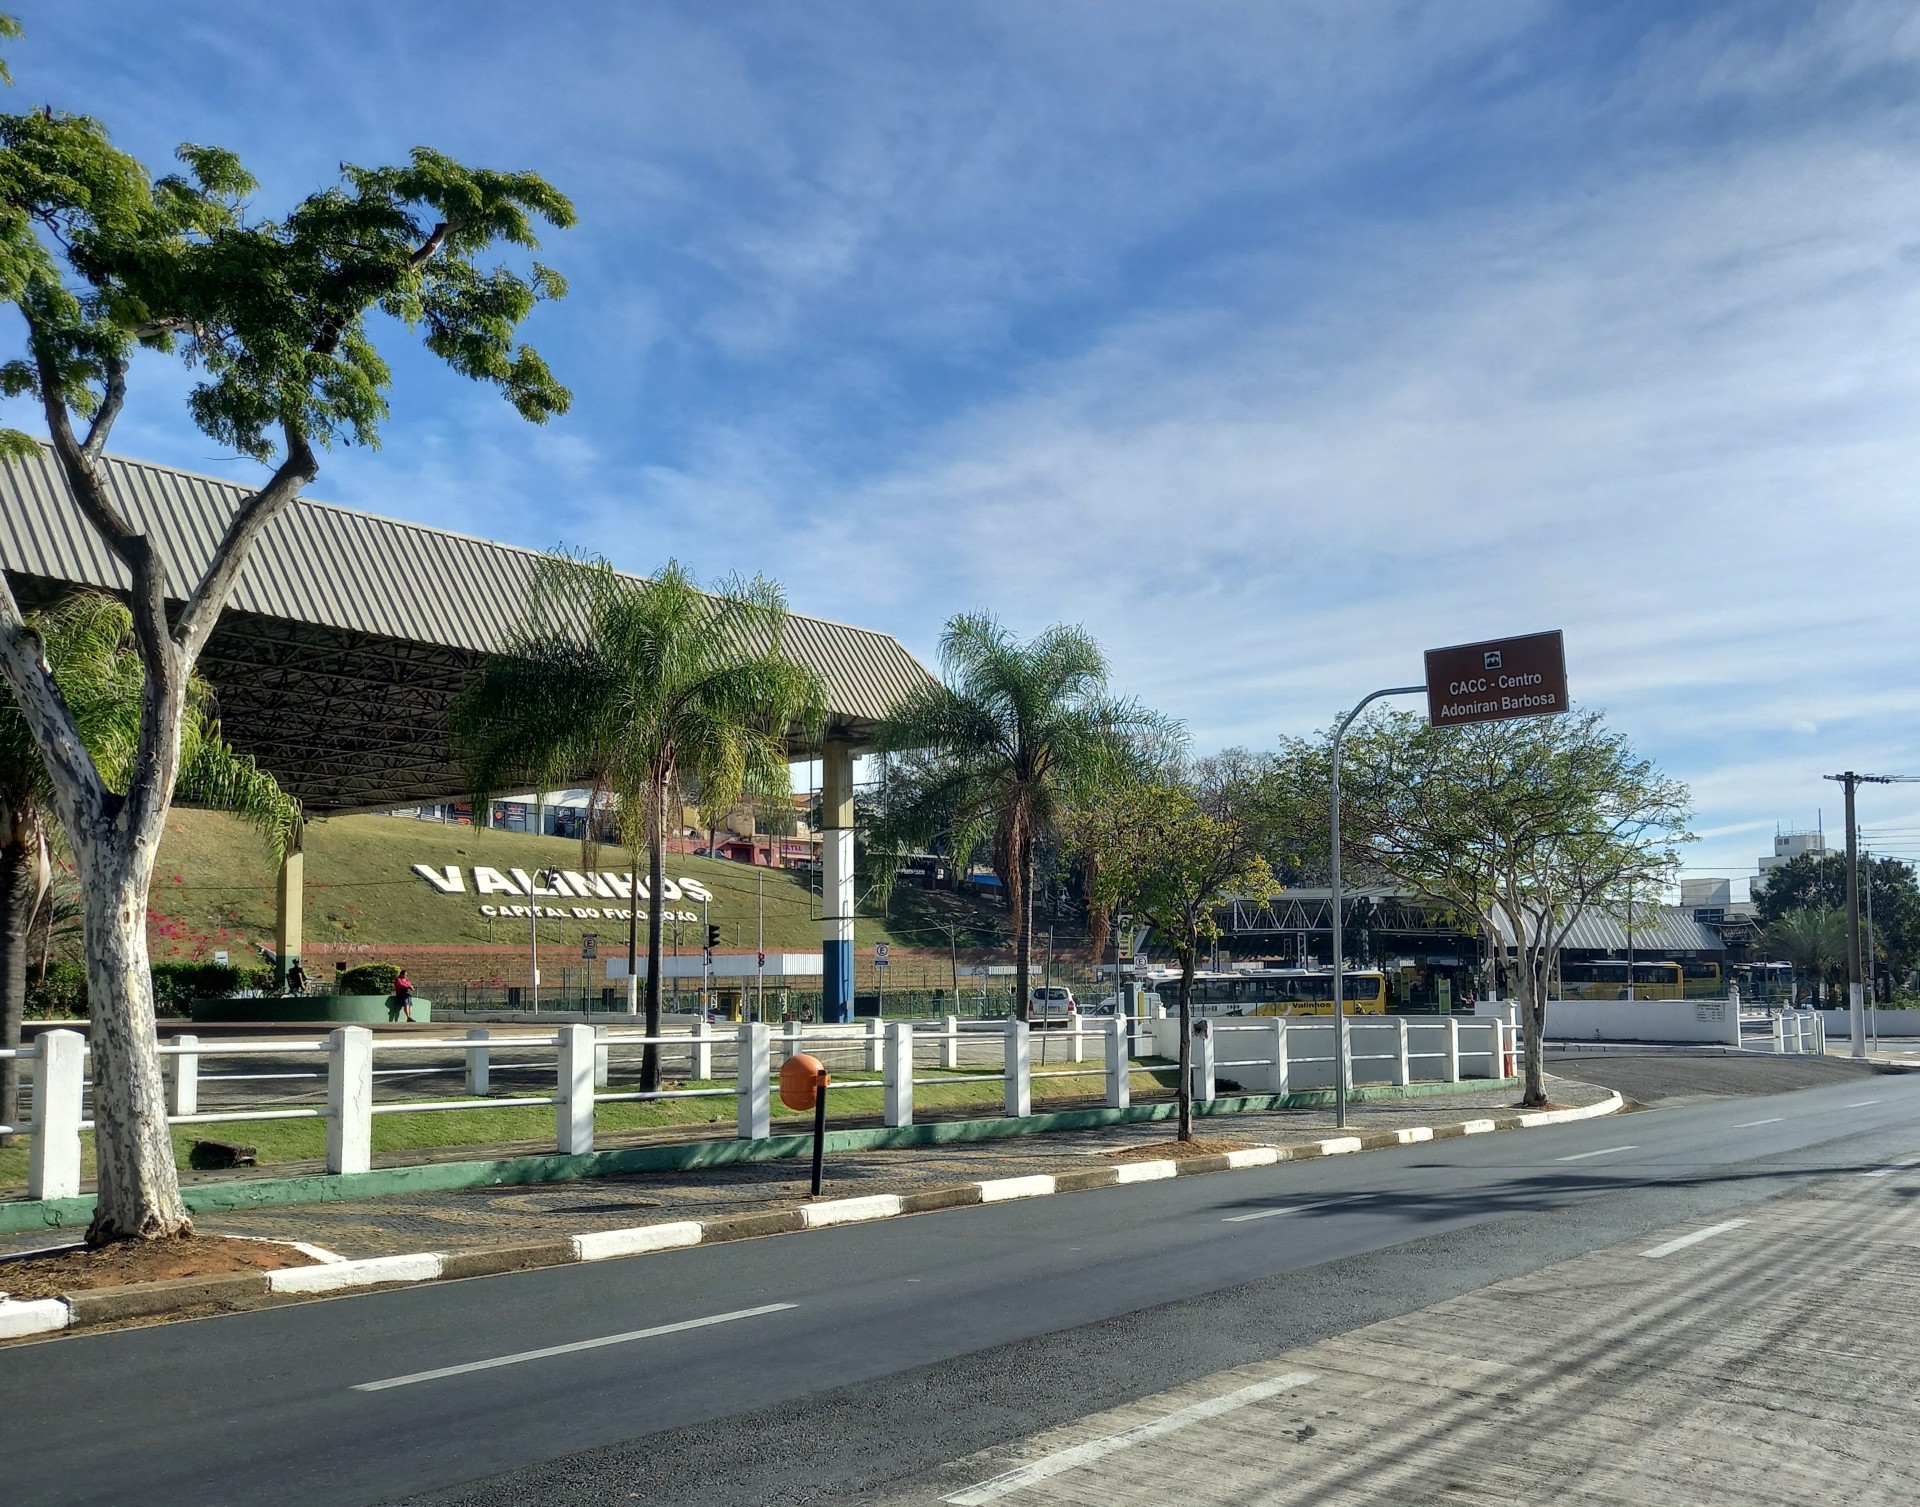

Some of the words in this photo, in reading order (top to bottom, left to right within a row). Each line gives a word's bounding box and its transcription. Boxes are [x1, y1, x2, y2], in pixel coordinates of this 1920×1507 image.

[1449, 678, 1487, 696] CACC
[1498, 672, 1542, 689] Centro
[1440, 700, 1498, 718] Adoniran
[1501, 693, 1556, 710] Barbosa
[412, 864, 713, 904] VALINHOS
[480, 904, 572, 919] CAPITAL
[571, 907, 600, 919] DO
[1292, 1001, 1331, 1009] Valinhos
